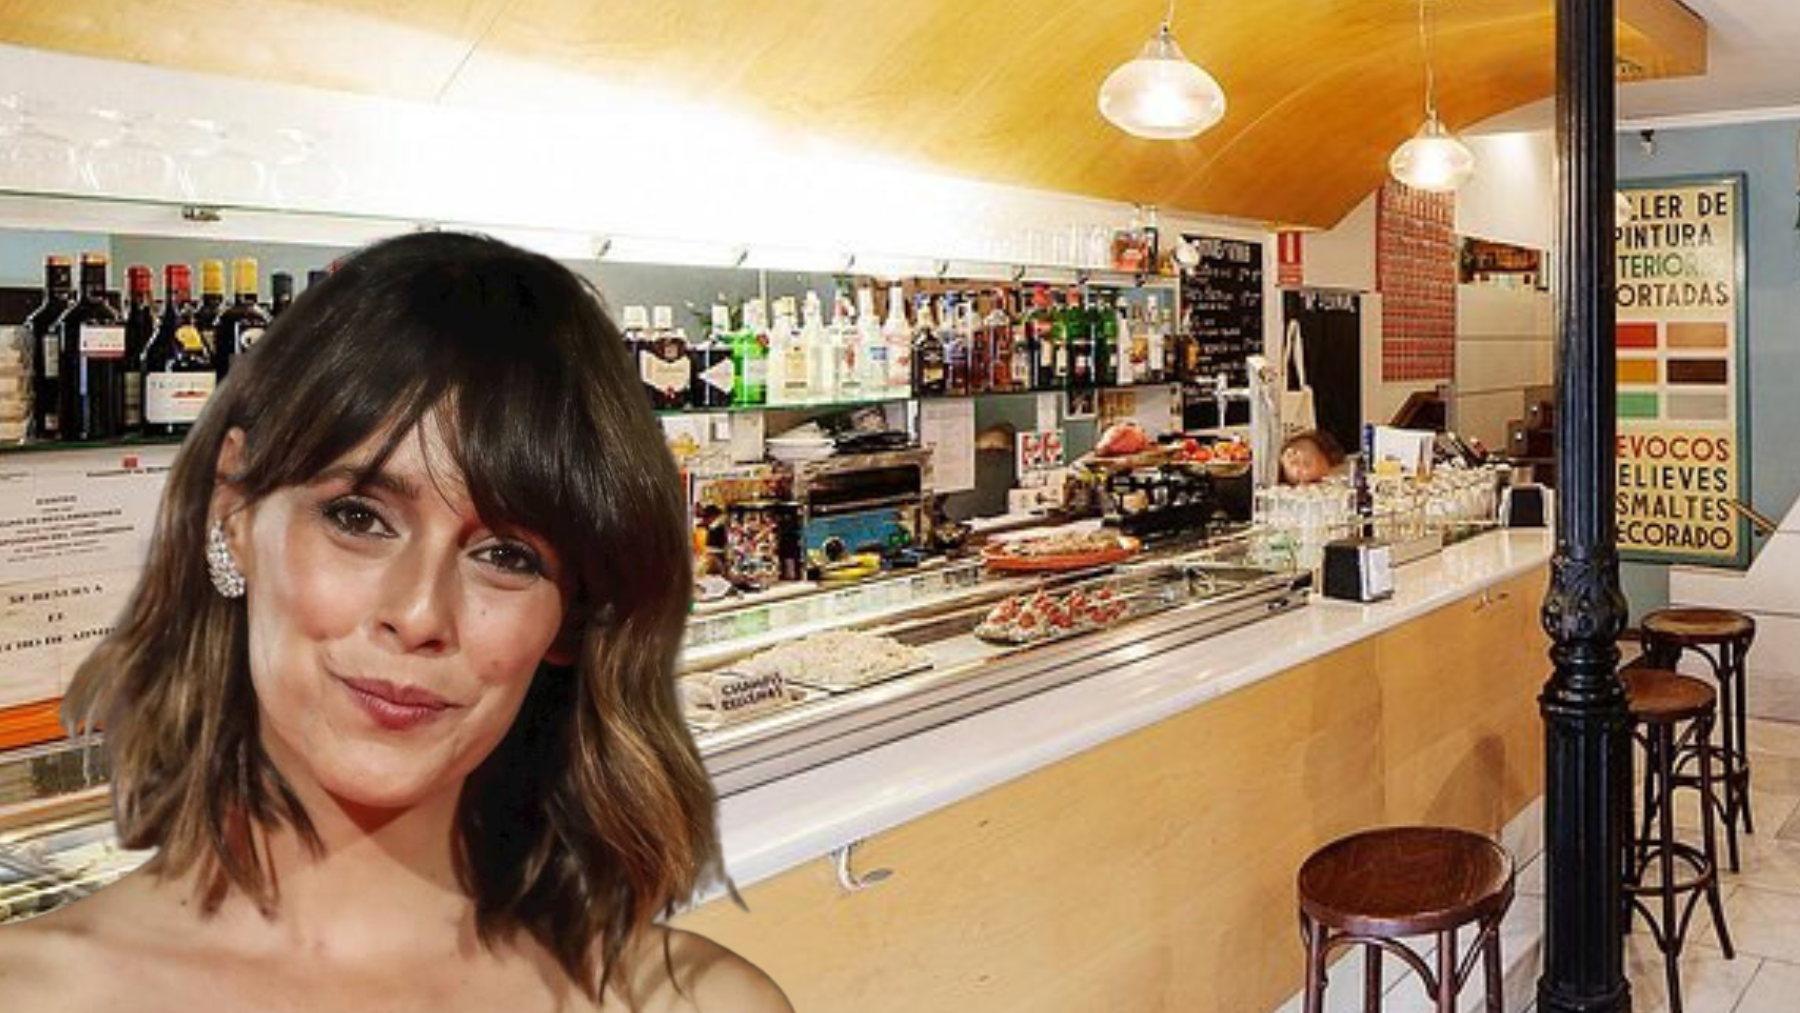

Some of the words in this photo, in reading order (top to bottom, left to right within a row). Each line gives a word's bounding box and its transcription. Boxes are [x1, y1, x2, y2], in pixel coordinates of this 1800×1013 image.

[1628, 194, 1682, 220] LER
[1698, 191, 1727, 217] DE
[1615, 434, 1730, 462] EVOCOS
[1619, 463, 1728, 493] ELIEVES
[1615, 491, 1730, 521] SMALTES
